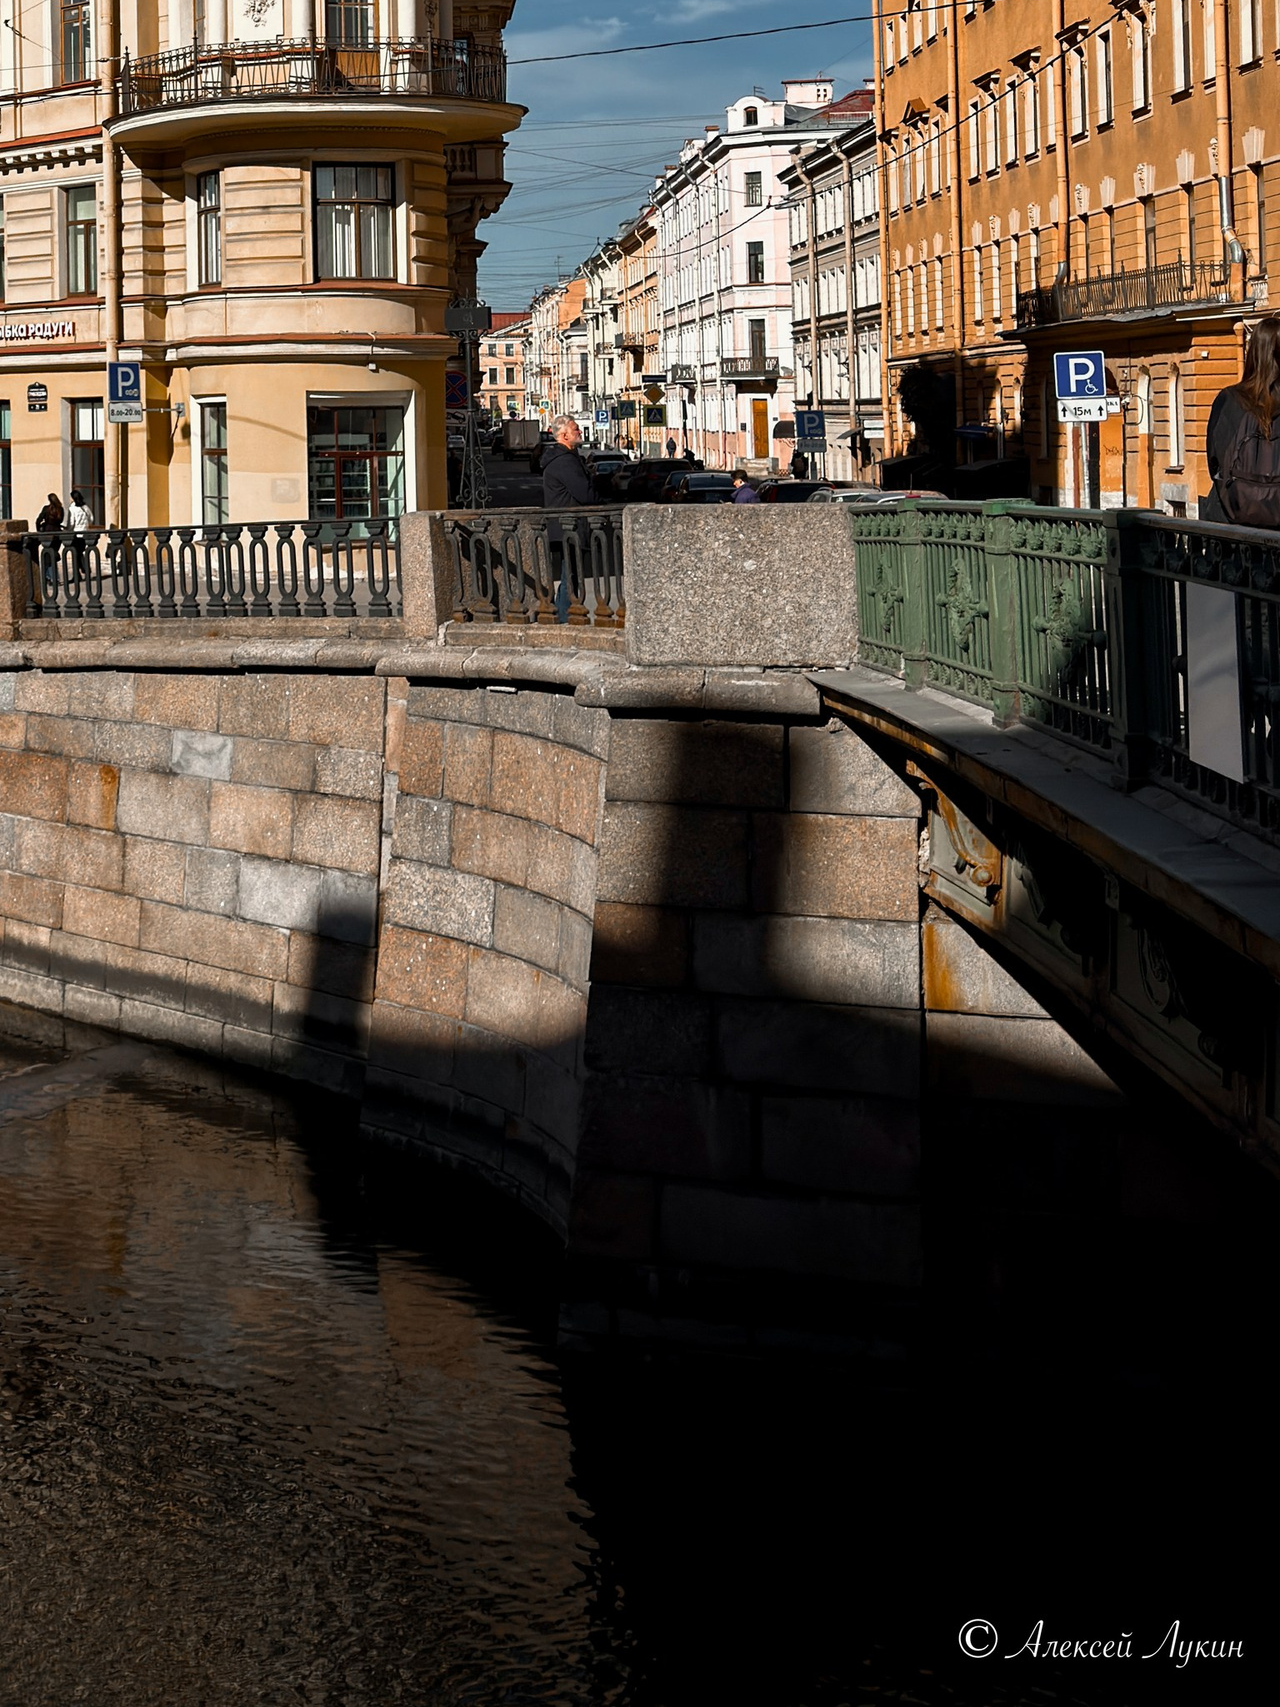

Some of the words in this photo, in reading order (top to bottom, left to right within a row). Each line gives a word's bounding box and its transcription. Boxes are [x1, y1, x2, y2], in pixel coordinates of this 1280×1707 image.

[117, 366, 135, 397] P
[1068, 357, 1095, 393] P
[803, 413, 820, 434] P
